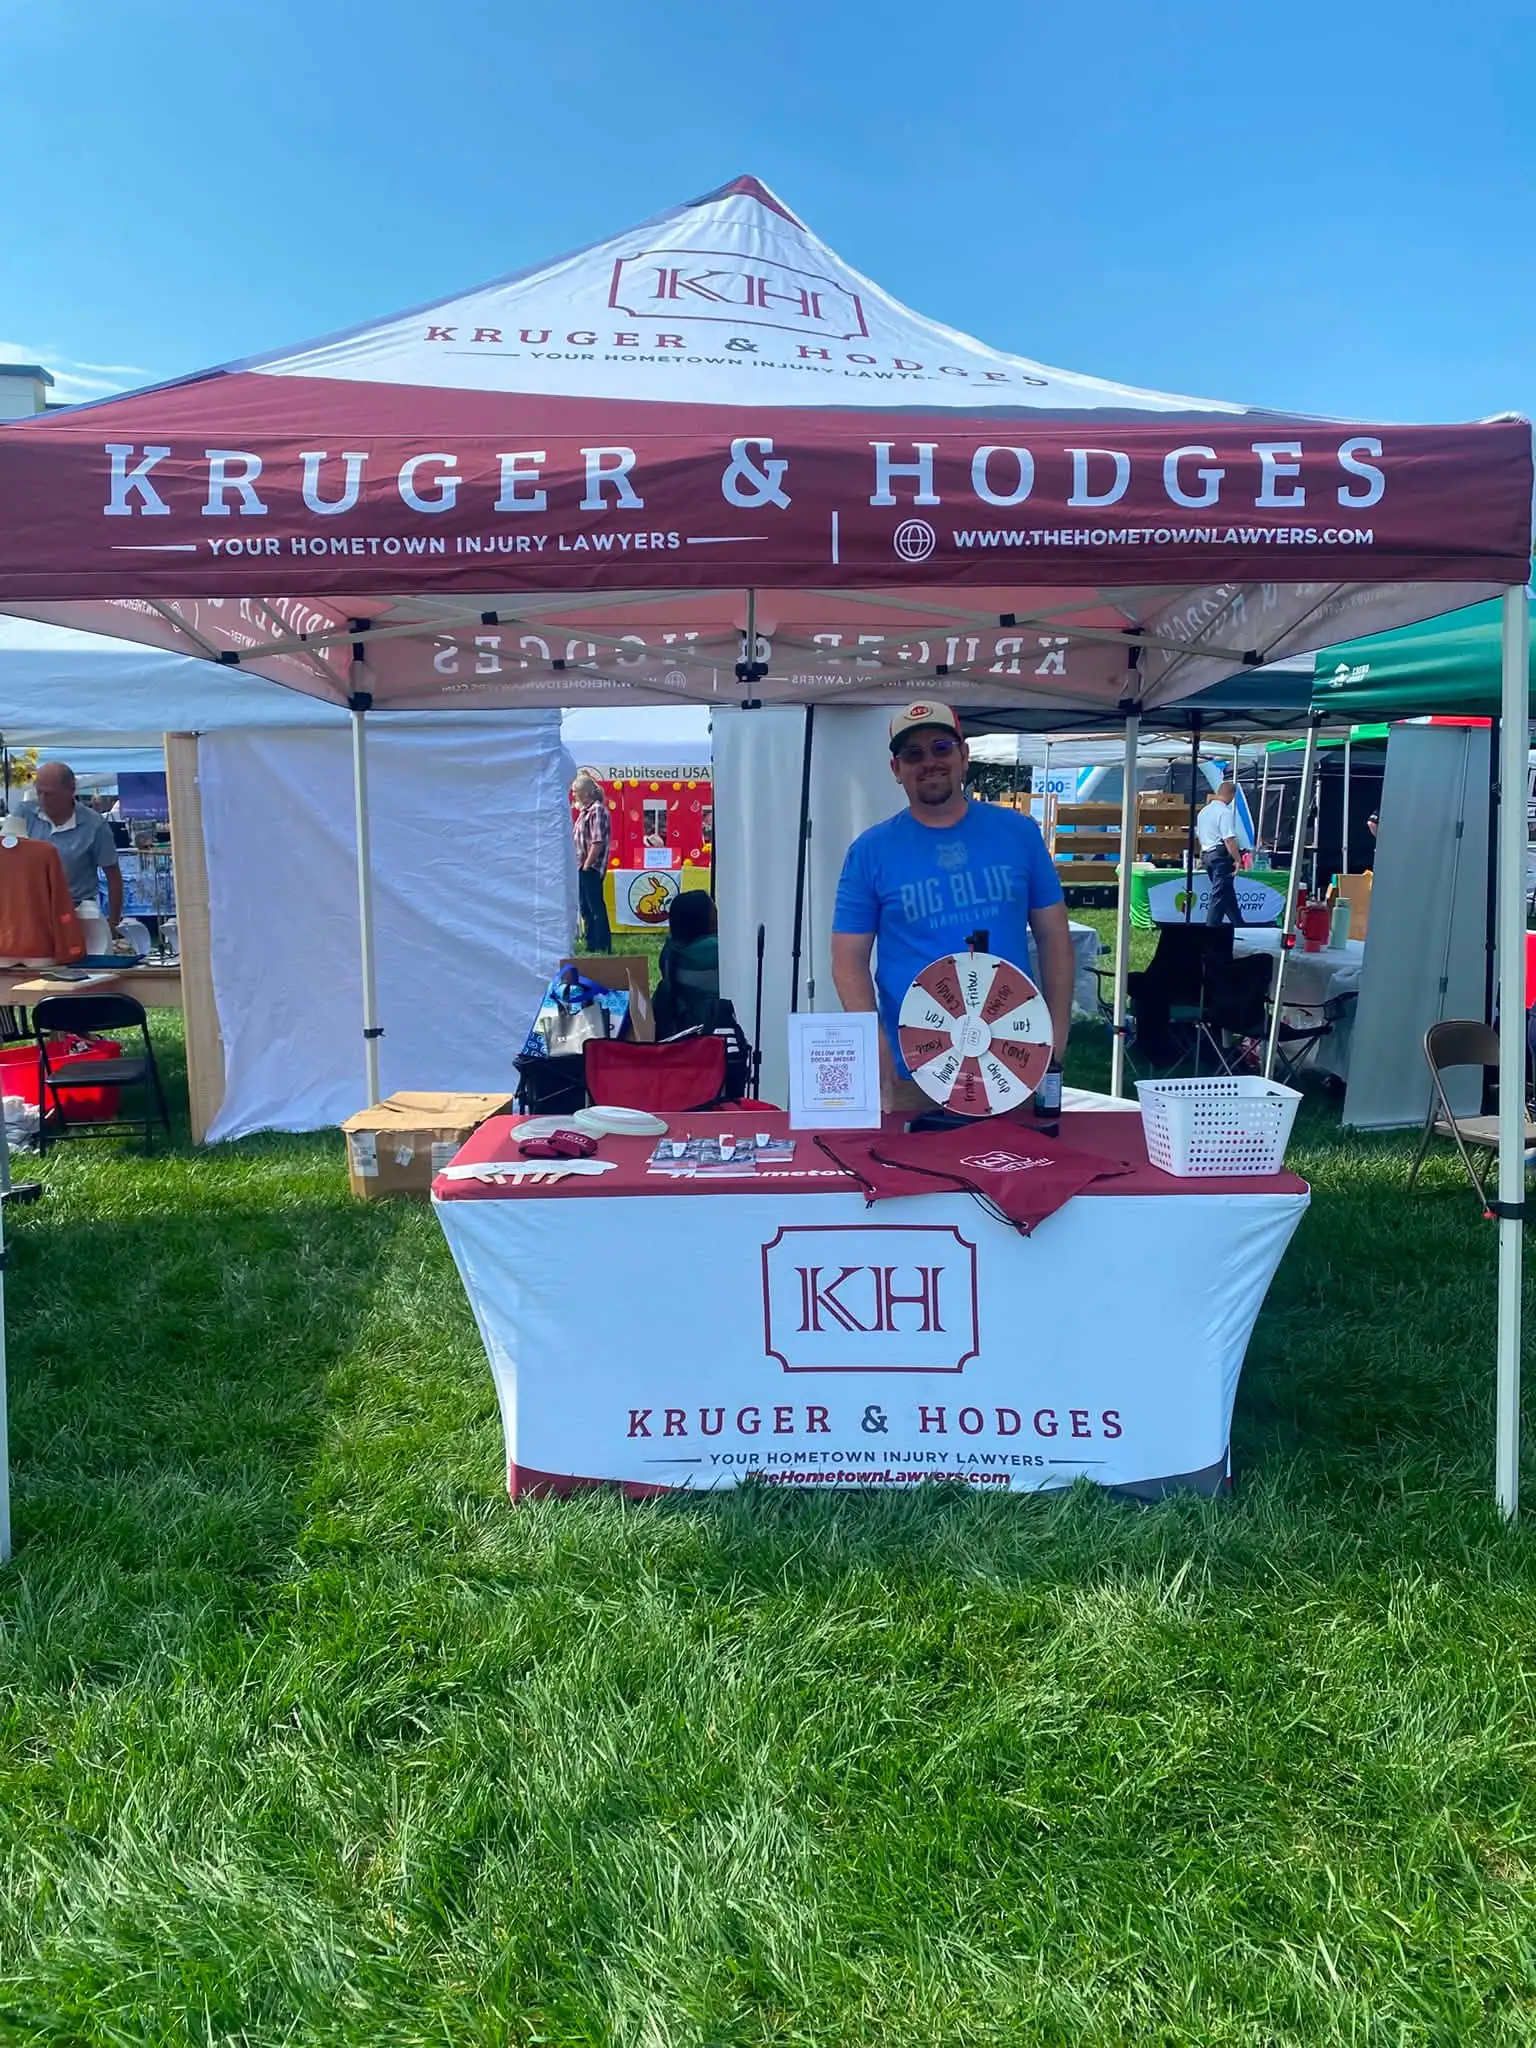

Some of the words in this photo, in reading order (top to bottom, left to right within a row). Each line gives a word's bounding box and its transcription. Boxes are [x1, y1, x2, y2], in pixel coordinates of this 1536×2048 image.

[649, 267, 825, 320] KH
[424, 325, 687, 348] KRUGER
[725, 337, 760, 353] &
[795, 344, 1049, 387] HODGES
[530, 351, 595, 361] YOUR
[604, 353, 743, 365] HOMETOWN
[752, 360, 834, 374] INJURY
[843, 369, 942, 382] LAWYE
[103, 443, 645, 517] KRUGER
[721, 437, 791, 510] &
[868, 436, 1388, 509] HODGES
[207, 536, 281, 557] YOUR
[290, 535, 446, 556] HOMETOWN
[455, 534, 548, 554] INJURY
[558, 531, 681, 551] LAWYERS
[952, 527, 1375, 548] WWW.THEHOMETOWNLAWYERS.COM
[609, 766, 679, 778] Rabbitseed
[683, 767, 710, 777] USA
[901, 878, 943, 923] BIG
[952, 865, 1016, 905] BLUE
[1199, 893, 1266, 902] ODOOR
[929, 907, 1000, 929] HAMILTON
[1012, 1018, 1031, 1033] fan
[932, 1055, 959, 1084] Candy
[794, 1266, 947, 1333] KH
[626, 1405, 832, 1438] KRUGER
[860, 1404, 889, 1435] &
[918, 1406, 1124, 1439] HODGES
[709, 1453, 760, 1465] YOUR
[767, 1450, 874, 1465] HOMETOWN
[883, 1451, 949, 1464] INJURY
[956, 1451, 1044, 1467] LAWYERS
